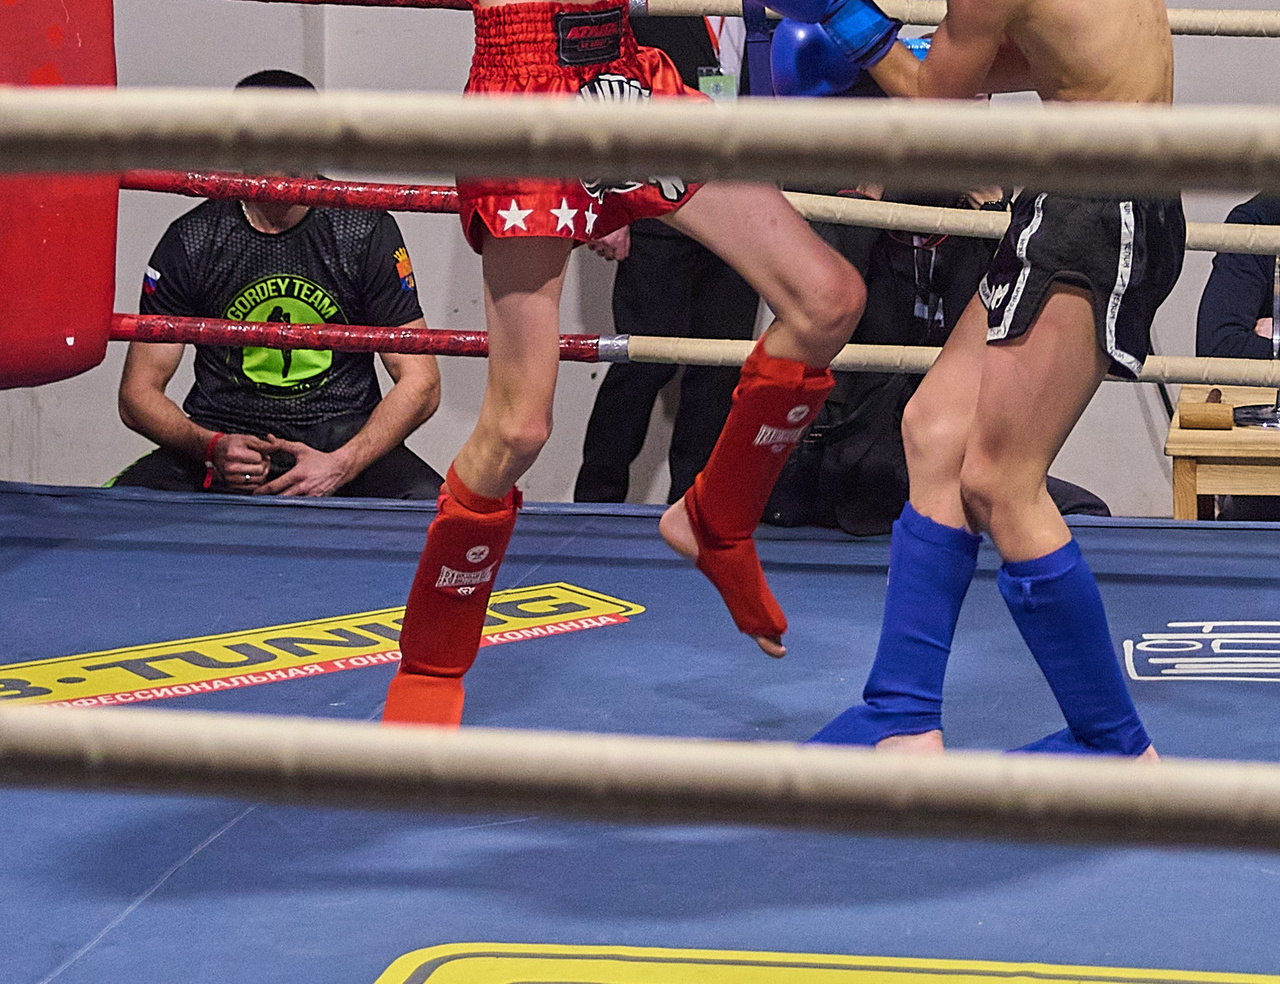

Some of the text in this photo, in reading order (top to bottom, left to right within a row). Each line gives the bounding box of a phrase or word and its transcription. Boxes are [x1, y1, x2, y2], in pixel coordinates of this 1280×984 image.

[226, 278, 339, 322] GORDEY TEAM
[485, 615, 618, 644] КОМАНДА
